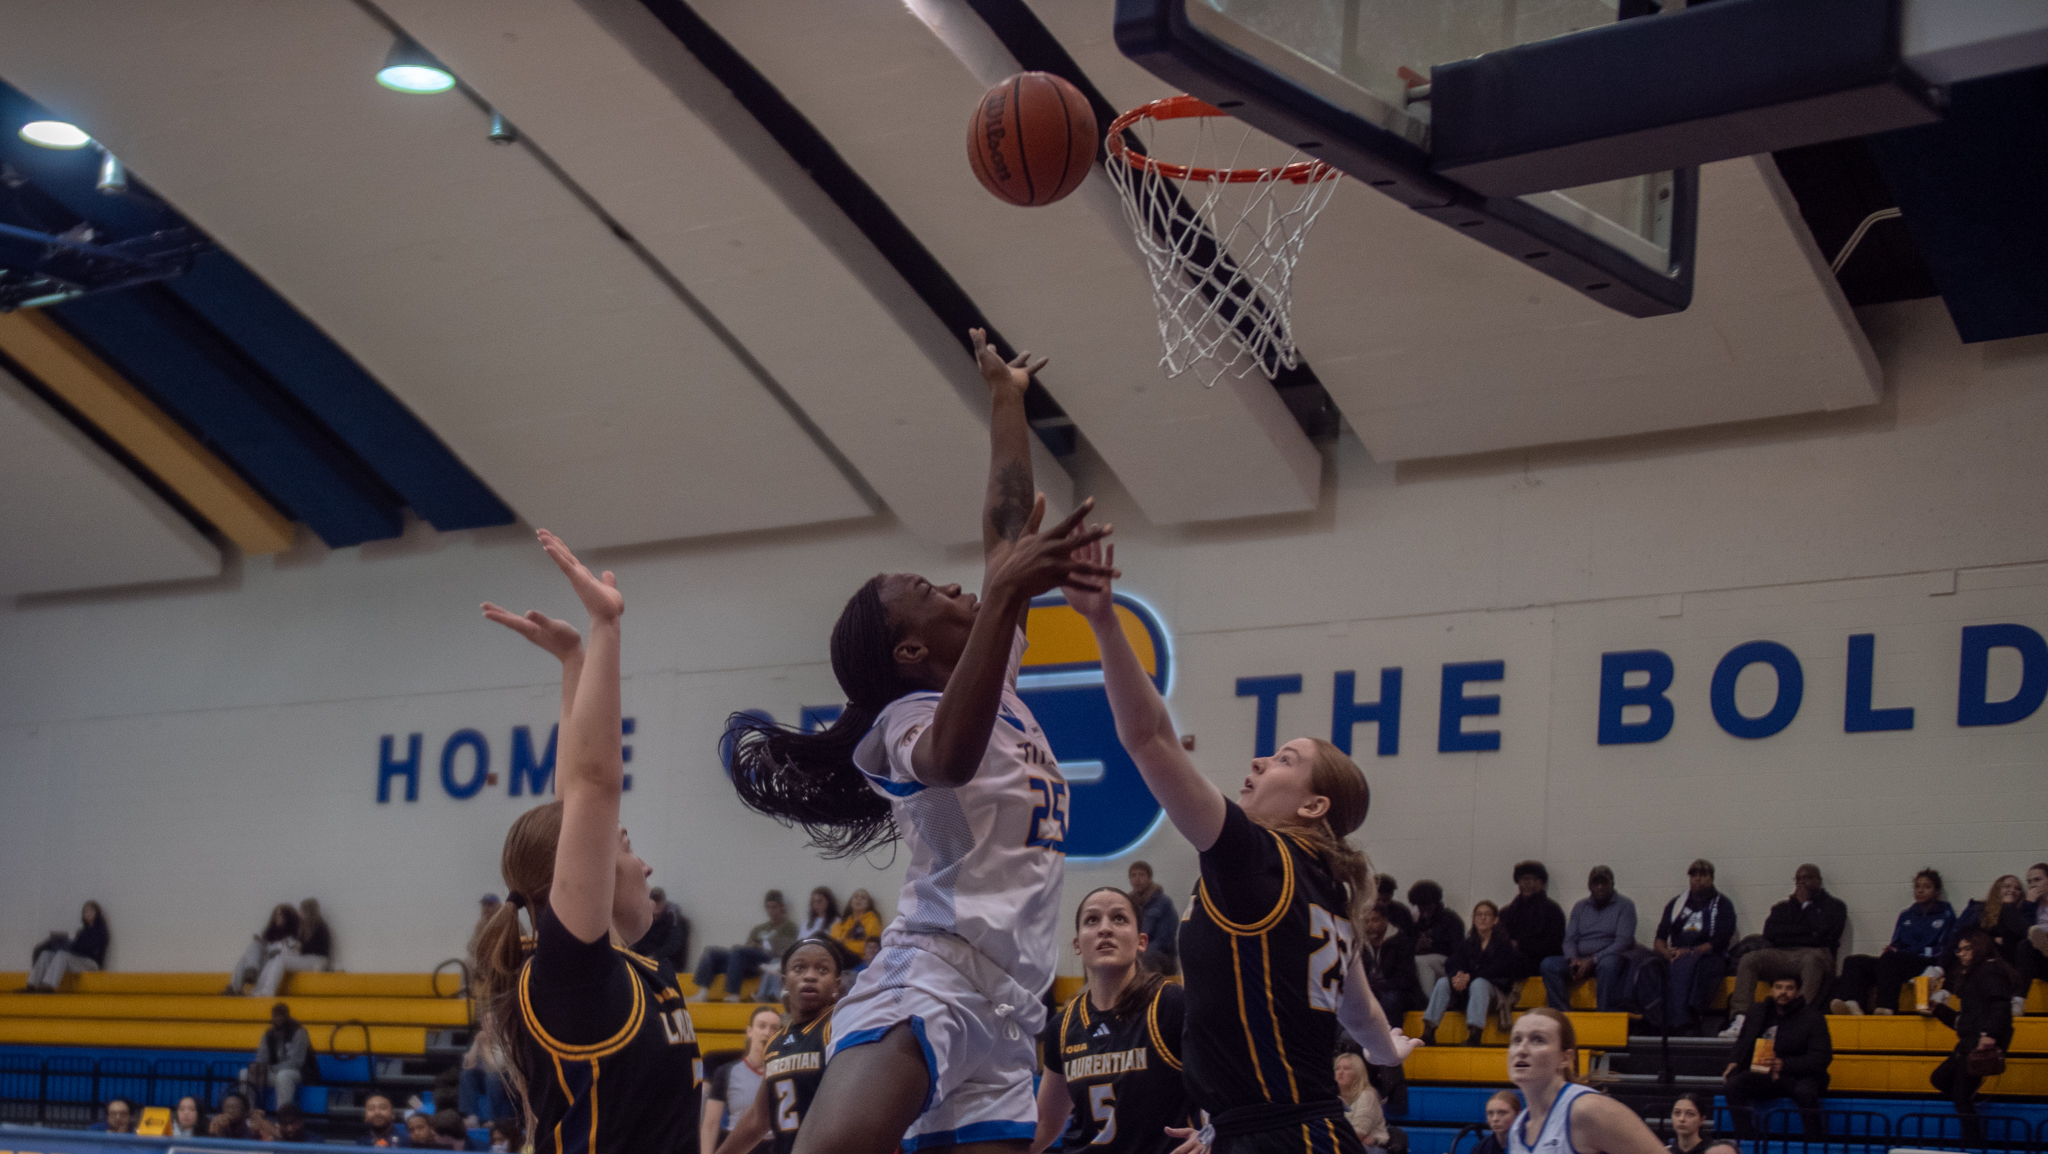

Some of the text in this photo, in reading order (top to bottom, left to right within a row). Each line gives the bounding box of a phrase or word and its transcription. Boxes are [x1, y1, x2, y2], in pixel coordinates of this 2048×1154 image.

[985, 92, 1011, 182] Wilson
[1235, 659, 1505, 757] THE
[1597, 622, 2048, 746] BOLD
[1024, 774, 1067, 856] 25
[1063, 1047, 1149, 1083] LAURENTIAN
[775, 1079, 799, 1131] 2
[1088, 1083, 1117, 1145] 5
